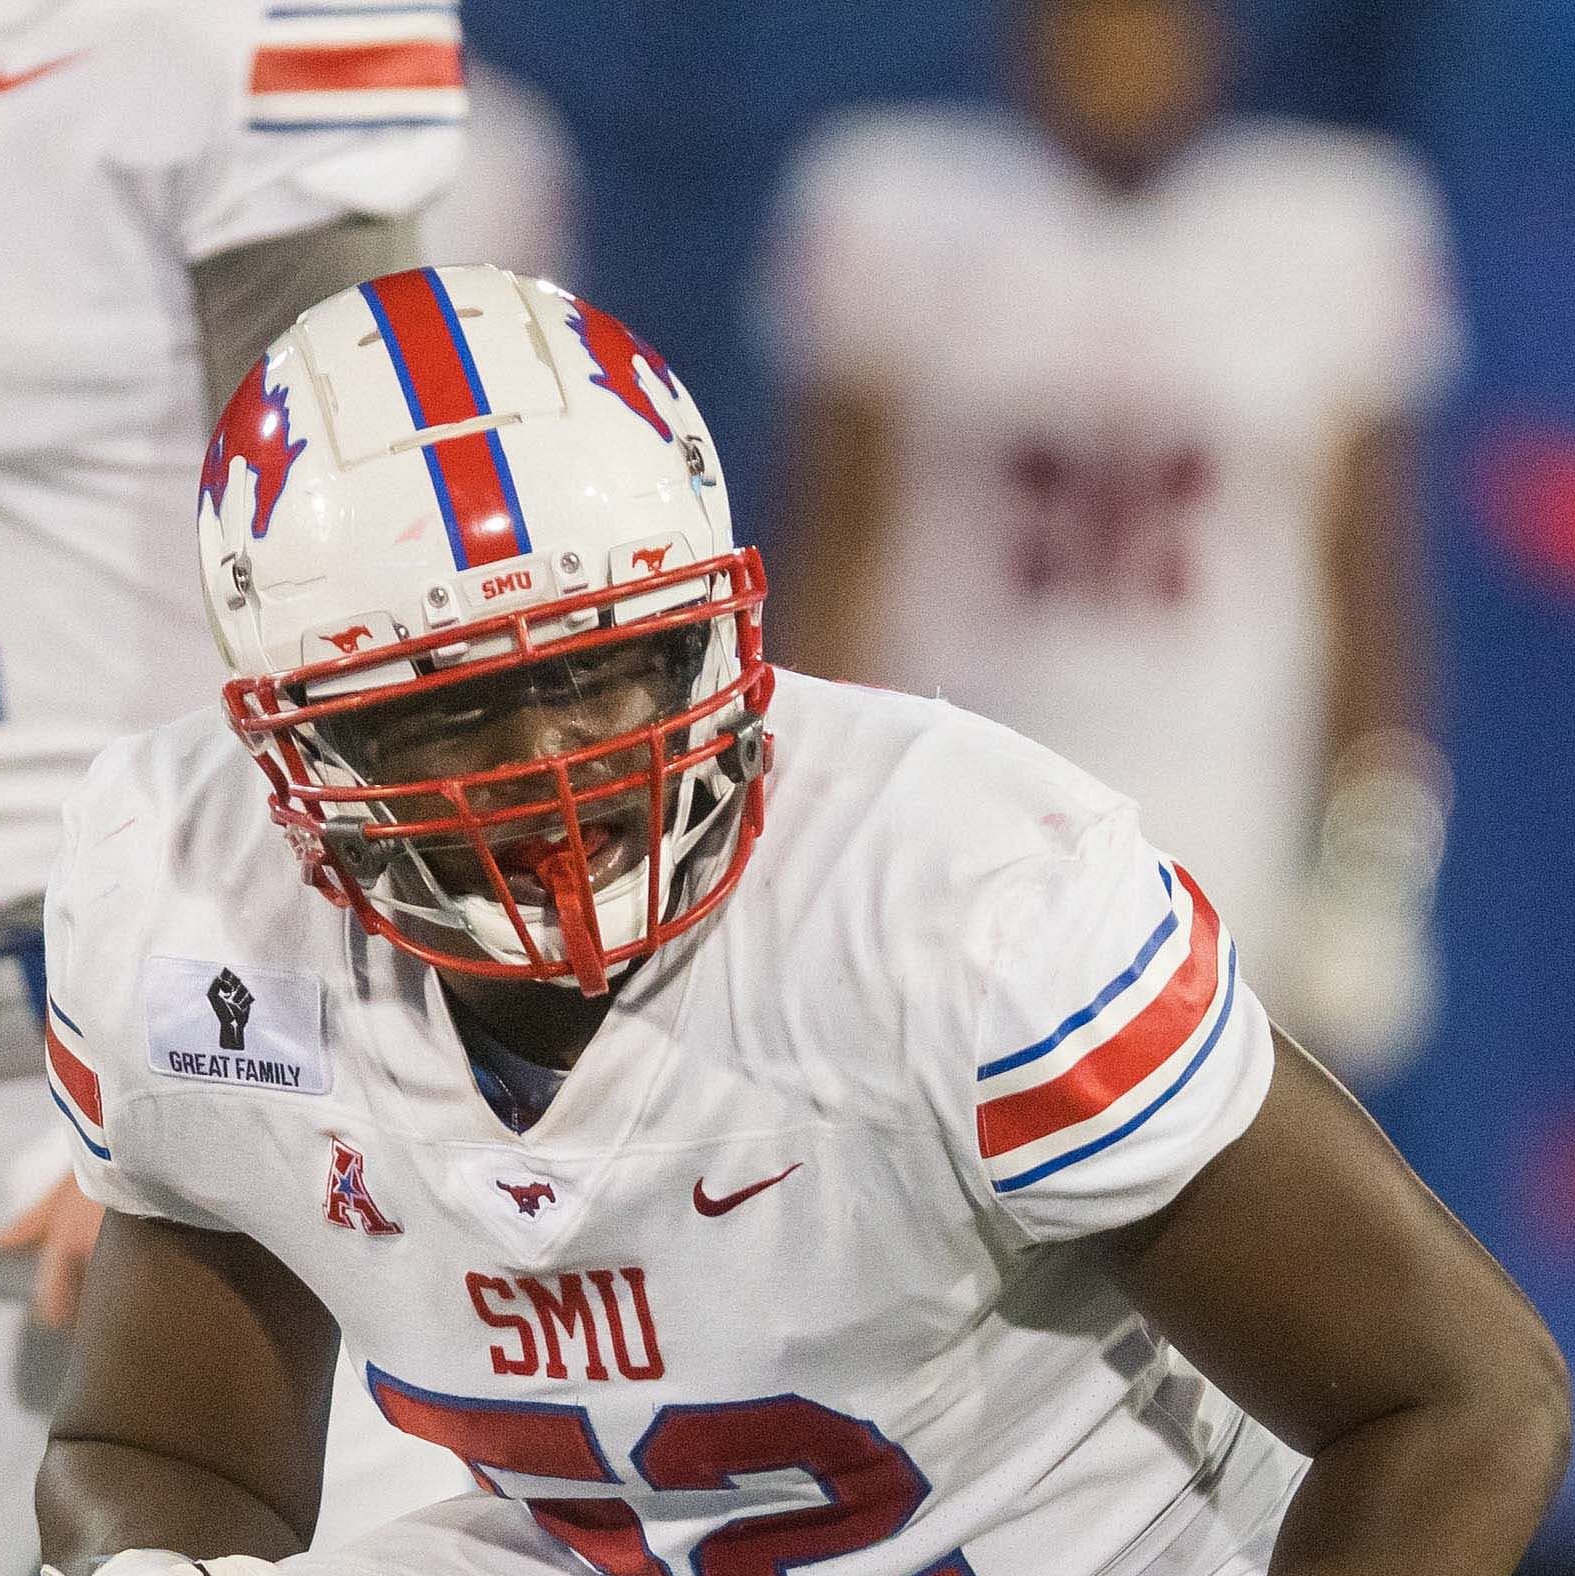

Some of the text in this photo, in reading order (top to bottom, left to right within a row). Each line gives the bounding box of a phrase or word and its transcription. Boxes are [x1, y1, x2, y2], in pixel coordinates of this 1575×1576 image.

[481, 570, 533, 600] SMU
[169, 1051, 301, 1087] GREAT FAMILY
[465, 1266, 666, 1382] SMU
